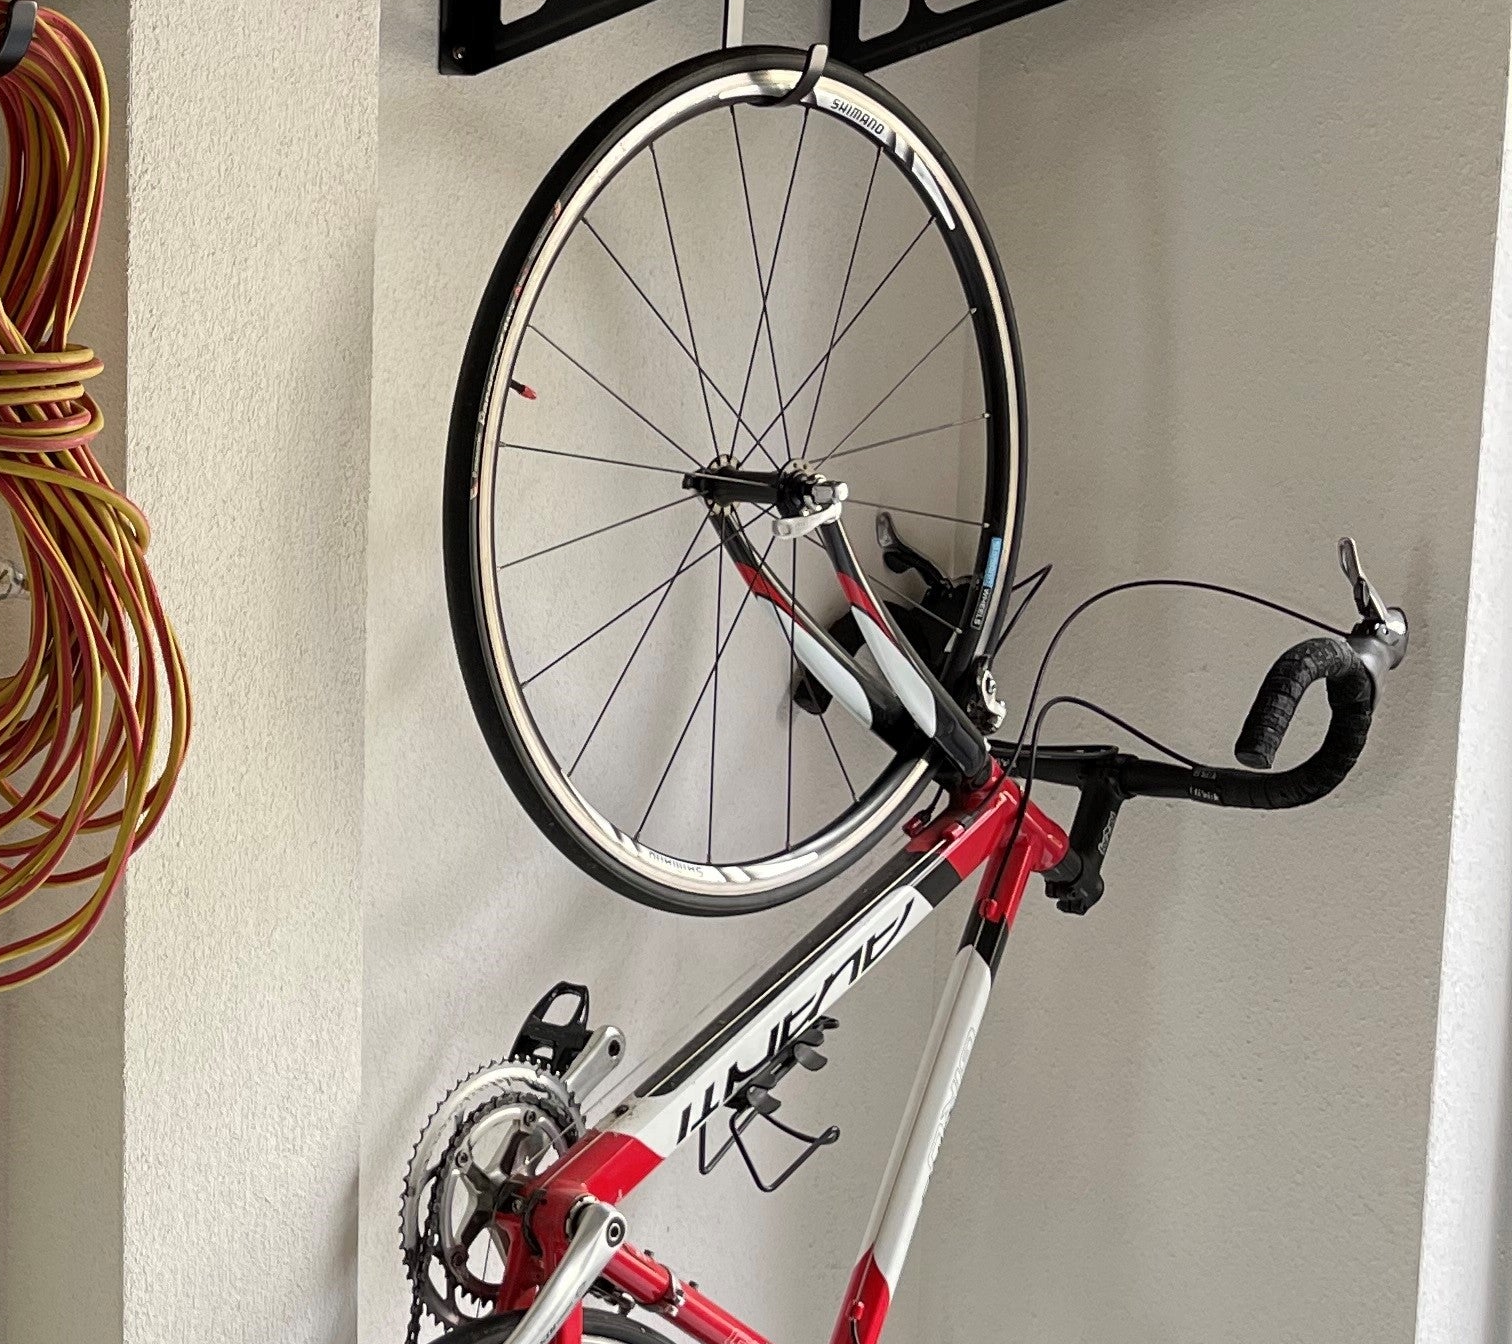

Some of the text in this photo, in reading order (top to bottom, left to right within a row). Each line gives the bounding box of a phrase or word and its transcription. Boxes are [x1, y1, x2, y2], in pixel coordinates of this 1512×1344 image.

[830, 96, 885, 135] SHIMANO
[973, 587, 990, 626] WHEELS
[676, 897, 915, 1145] AVANTI
